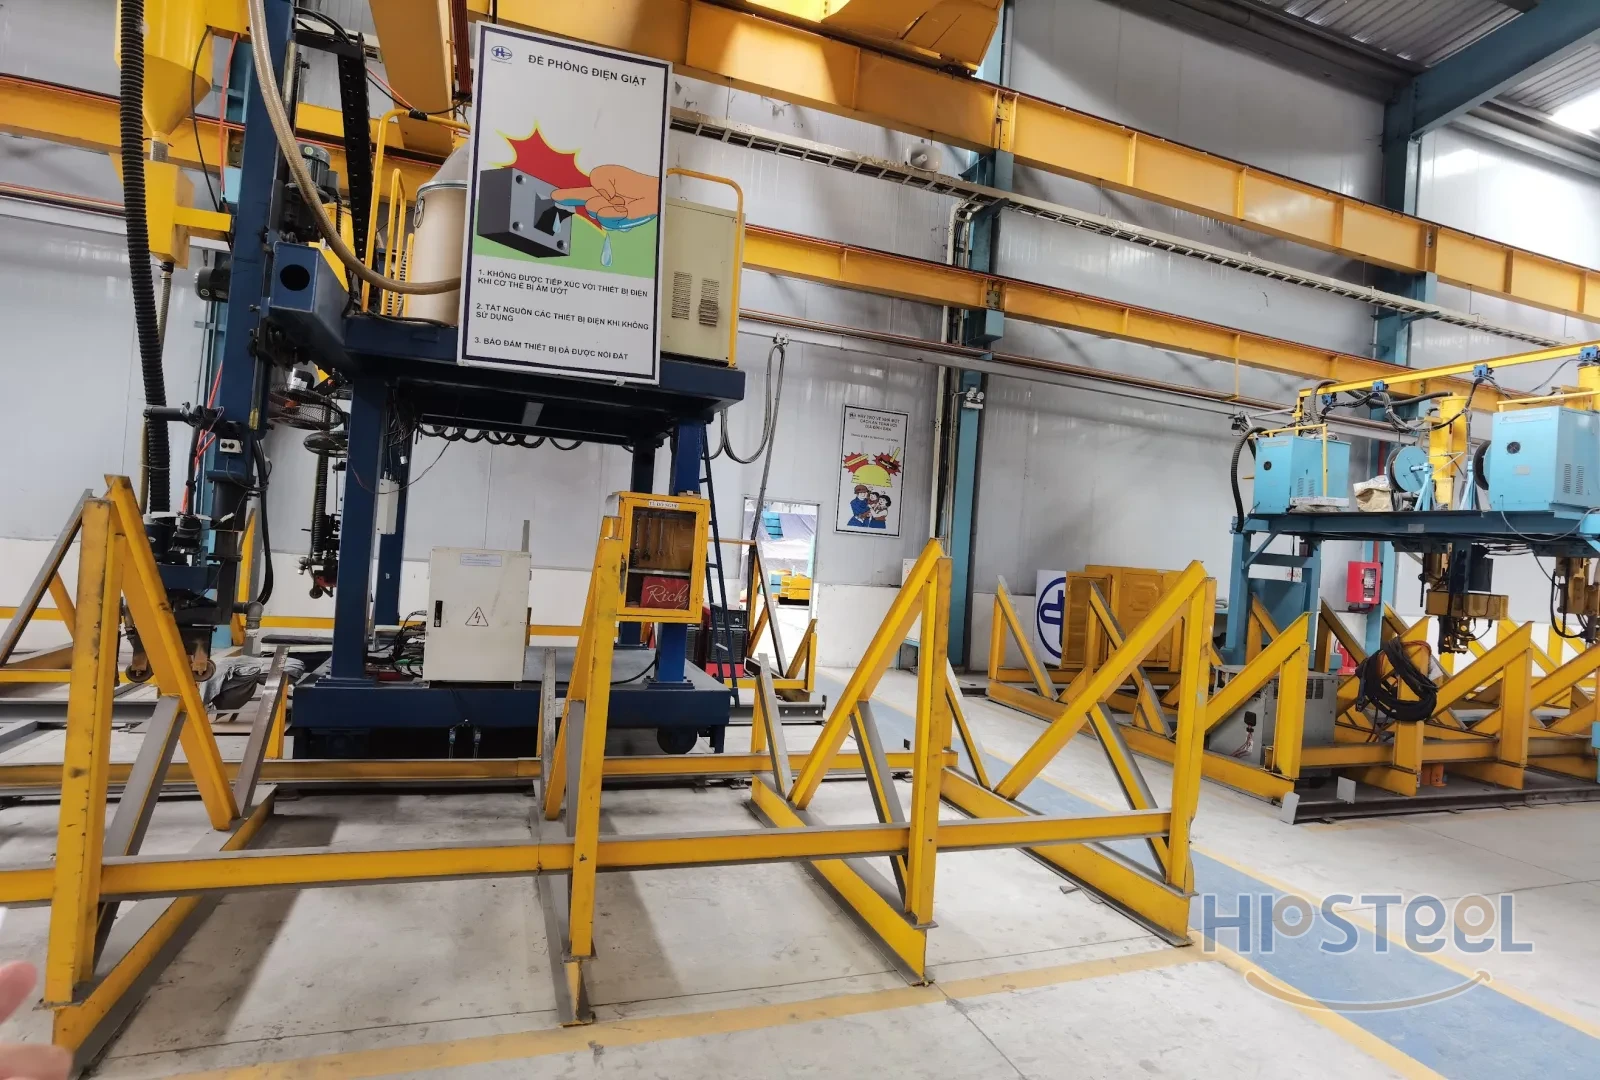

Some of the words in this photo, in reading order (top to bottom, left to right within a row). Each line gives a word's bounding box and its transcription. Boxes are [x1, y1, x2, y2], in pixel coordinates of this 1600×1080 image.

[547, 58, 588, 75] PHÒNG
[592, 68, 618, 81] ĐIỆN
[620, 74, 647, 86] GIẬT
[487, 270, 517, 280] KHÔNG
[519, 275, 543, 283] ĐƯỢC
[582, 282, 596, 290] VỚI
[598, 285, 619, 294] THIẾT
[621, 288, 629, 296] BỊ
[526, 284, 534, 292] BỊ
[550, 287, 568, 295] ƯỚT
[490, 313, 514, 321] DỤNG
[535, 309, 551, 318] CÁC
[553, 313, 575, 322] THIẾT
[578, 316, 585, 324] BỊ
[587, 317, 605, 325] ĐIỆN
[607, 319, 620, 327] KHI
[622, 321, 649, 330] KHÔNG
[524, 342, 546, 351] THIẾT
[548, 346, 557, 354] BỊ
[572, 348, 596, 357] ĐƯỢC
